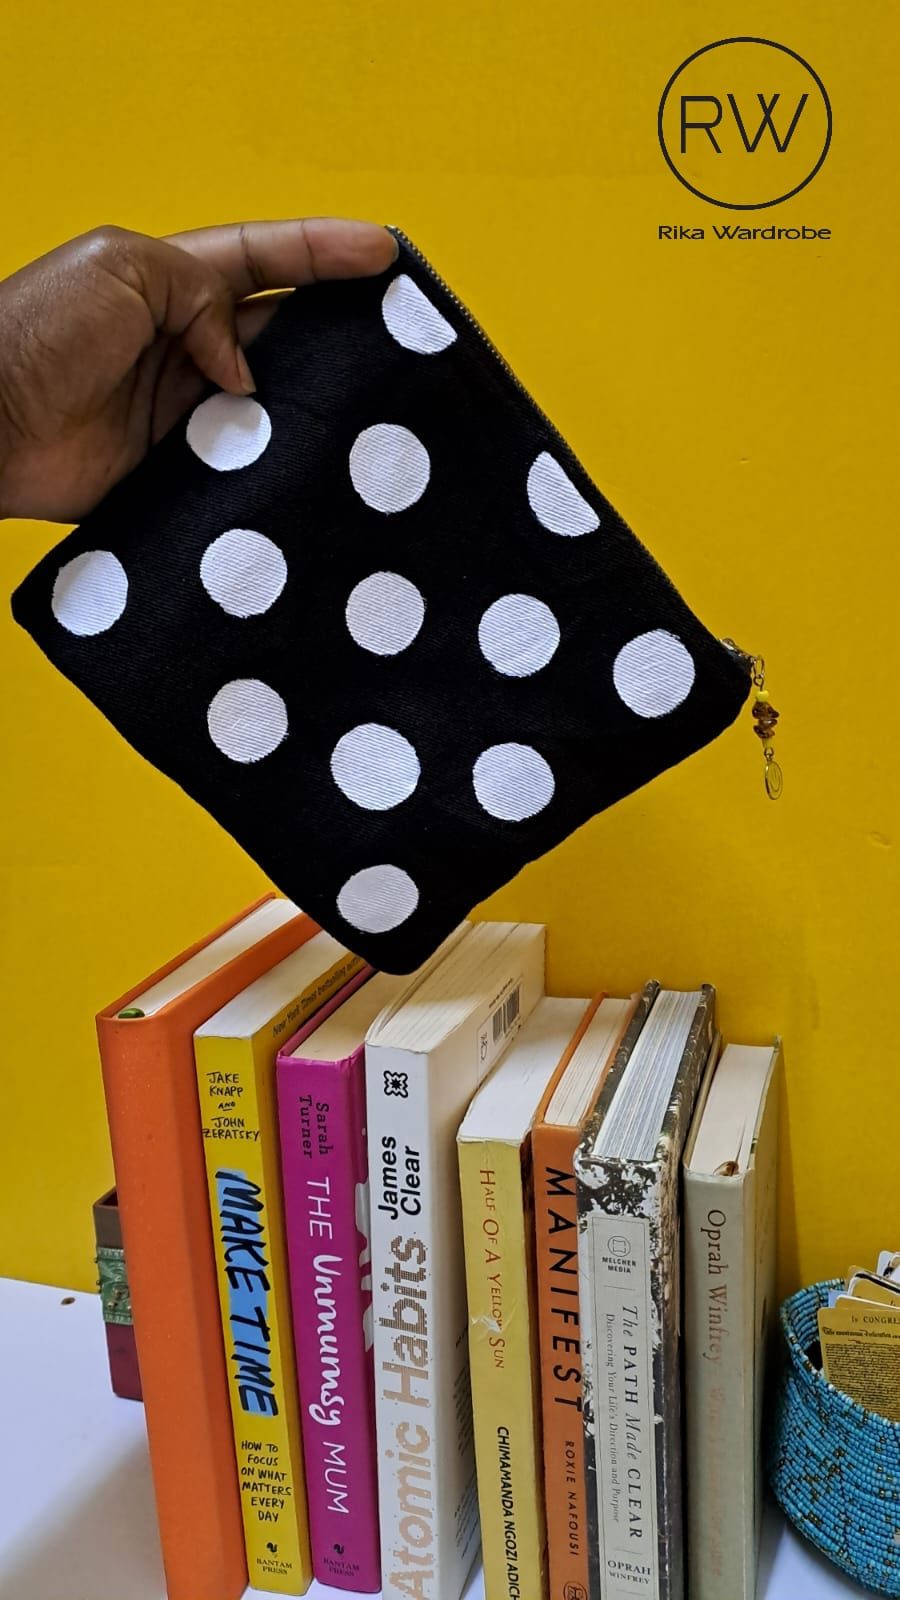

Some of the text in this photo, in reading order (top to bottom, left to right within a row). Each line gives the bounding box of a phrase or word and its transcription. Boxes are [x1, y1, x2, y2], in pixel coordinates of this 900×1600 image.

[206, 1071, 240, 1084] JAKE
[209, 1085, 244, 1097] KNAPP
[211, 1116, 245, 1128] JOHN
[299, 1094, 313, 1159] Turner
[316, 1102, 334, 1155] Sarah
[202, 1128, 260, 1141] ZERATSKY
[377, 1136, 399, 1220] James
[400, 1145, 421, 1216] Clear
[700, 1209, 729, 1275] Oprah
[485, 1249, 501, 1264] A
[602, 1256, 637, 1267] MELCHER
[607, 1265, 631, 1274] MEDIA
[215, 1171, 279, 1417] MAKE TIME
[545, 1166, 583, 1413] MANIFEST
[702, 1284, 730, 1364] Winfrey
[306, 1176, 350, 1514] THE Unmumsy MUM
[606, 1313, 615, 1368] Discovering
[608, 1371, 617, 1393] Your
[379, 1235, 434, 1600] Atomic Habits
[622, 1305, 643, 1538] The PATH Made CLEAR
[241, 1440, 279, 1453] HOW TO
[610, 1423, 618, 1465] Direction
[247, 1454, 279, 1466] FOCUS
[240, 1467, 287, 1482] ON WHAT
[497, 1426, 514, 1517] CHIMAMANDA
[611, 1467, 620, 1485] and
[241, 1482, 292, 1496] MATTERS
[564, 1440, 580, 1556] ROXIE NAFOUSI
[251, 1497, 285, 1509] EVERY
[610, 1488, 621, 1522] Purpose
[258, 1510, 279, 1522] DAY
[504, 1520, 518, 1561] NGOZI
[256, 1558, 293, 1569] BANTAM
[262, 1566, 288, 1575] PRESS
[607, 1559, 651, 1576] OPRAH
[609, 1571, 650, 1585] WINFREY
